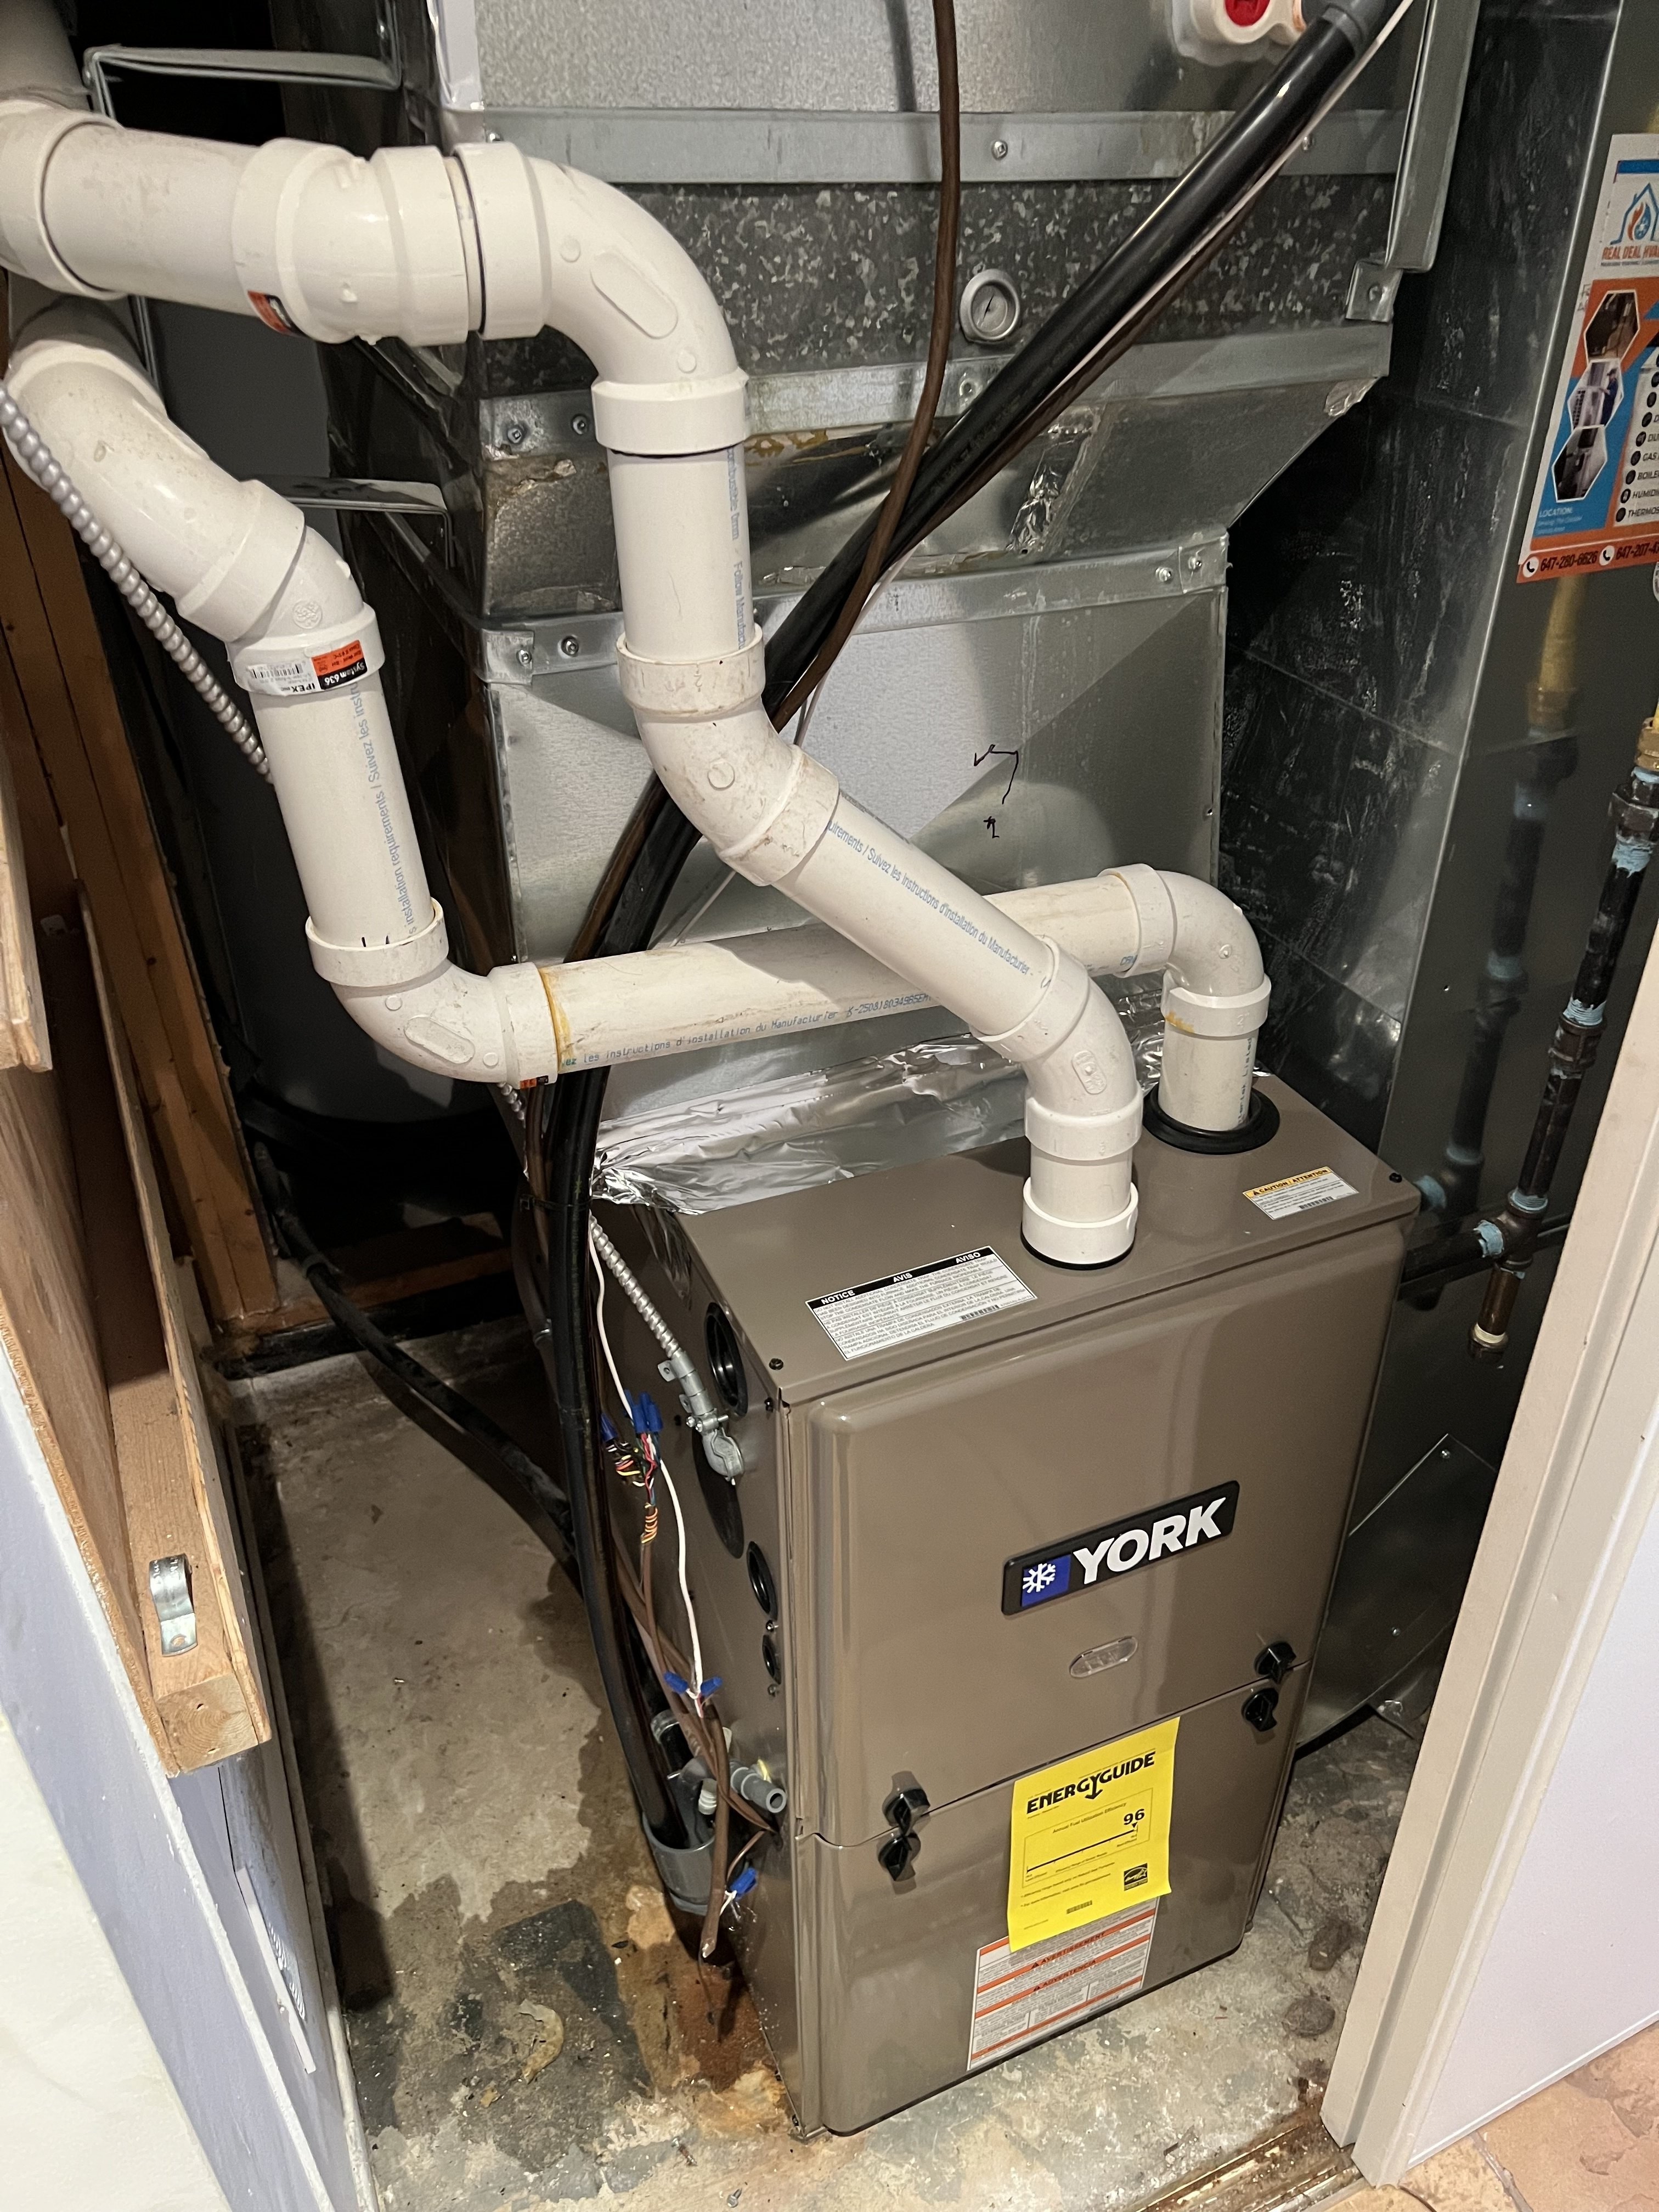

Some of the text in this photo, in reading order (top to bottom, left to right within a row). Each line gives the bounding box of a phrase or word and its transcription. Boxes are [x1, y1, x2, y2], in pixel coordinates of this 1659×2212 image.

[1602, 246, 1621, 260] REAL
[1622, 245, 1641, 259] DEAL
[1643, 453, 1656, 461] GAS
[1637, 470, 1659, 480] BOILE
[733, 561, 744, 595] Follow
[324, 675, 340, 685] 636
[340, 662, 365, 679] System
[292, 682, 315, 693] IPEX
[359, 719, 370, 740] les
[365, 742, 380, 782] Suivez
[376, 791, 401, 866] requirements
[394, 867, 414, 926] installation
[827, 820, 864, 853] uirements
[866, 847, 892, 873] Suivez
[890, 865, 902, 882] les
[901, 874, 940, 910] instructions
[938, 901, 980, 938] d'installation
[977, 929, 989, 945] du
[986, 936, 1031, 975] Manufacturier
[584, 1052, 599, 1063] les
[607, 1040, 670, 1059] instructions
[676, 1025, 749, 1047] d'installation
[756, 1022, 766, 1033] du
[771, 1009, 838, 1030] Manufacturier
[1259, 1181, 1288, 1193] CAUTION
[1293, 1169, 1328, 1183] ATTENTION
[821, 1251, 981, 1305] NOTICE AVIS AVISO
[1073, 1496, 1226, 1585] YORK
[1026, 1751, 1155, 1815] ENERGYGUIDE
[1123, 1808, 1145, 1826] 96
